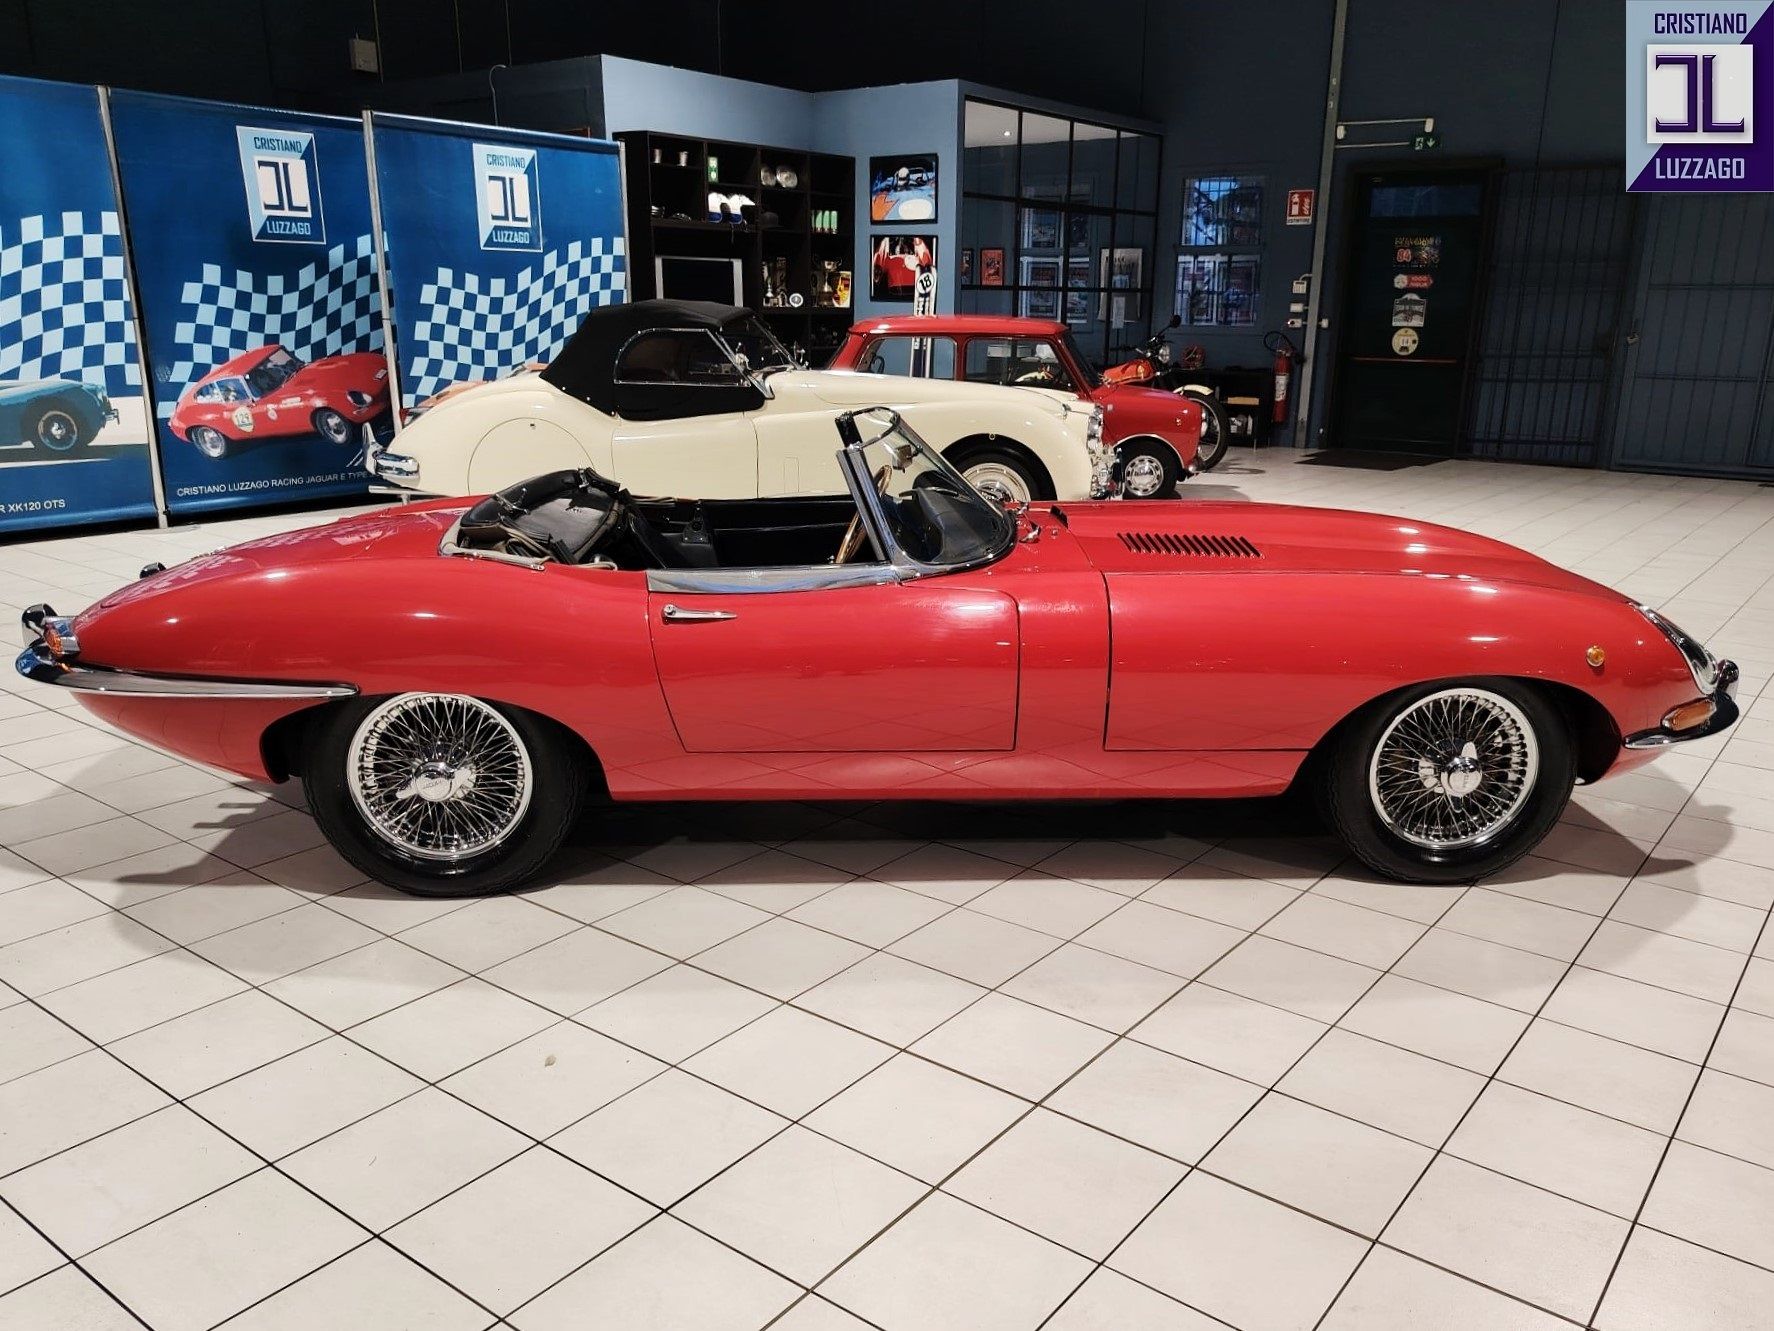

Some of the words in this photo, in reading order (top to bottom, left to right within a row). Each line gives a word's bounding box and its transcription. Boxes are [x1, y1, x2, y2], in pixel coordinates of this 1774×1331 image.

[254, 136, 302, 153] CRISTIANO
[486, 153, 526, 169] CRISTIANO
[266, 220, 311, 235] LUZZAGO
[492, 230, 530, 244] LUZZAGO
[919, 274, 932, 291] 18
[177, 484, 226, 497] CRISTIANO
[228, 480, 269, 492] LUZZAGO
[271, 476, 304, 488] RACING
[305, 473, 338, 484] JAGUAR
[340, 473, 346, 482] E
[348, 471, 368, 480] TYPE
[8, 501, 41, 513] XK120
[43, 499, 66, 509] OTS
